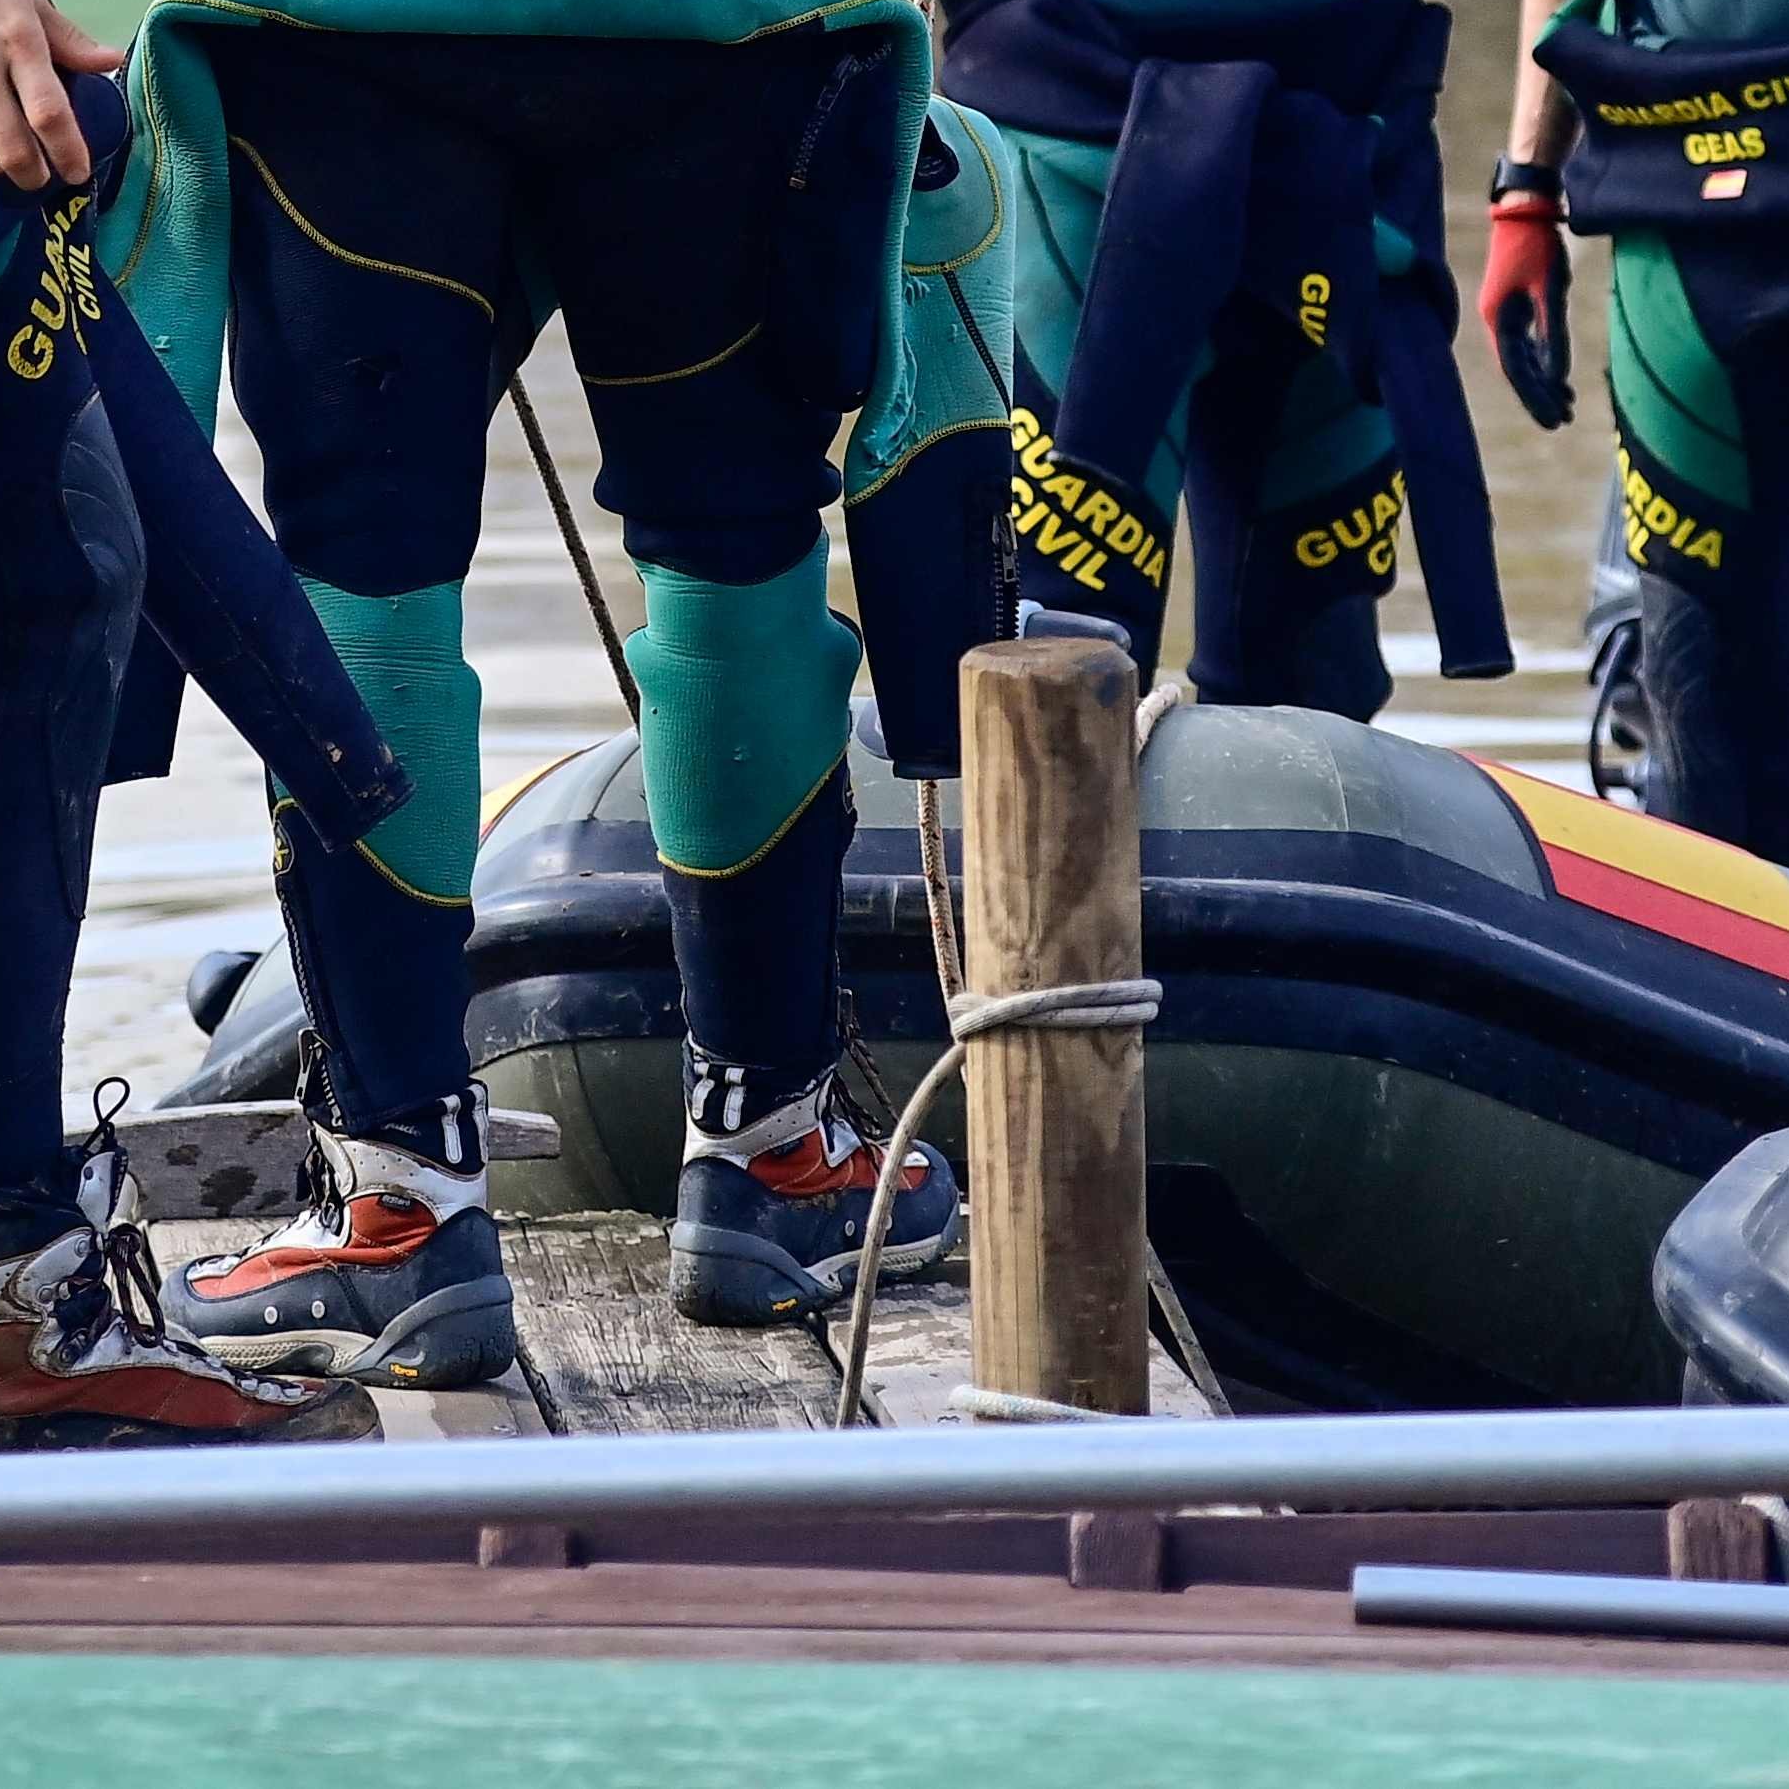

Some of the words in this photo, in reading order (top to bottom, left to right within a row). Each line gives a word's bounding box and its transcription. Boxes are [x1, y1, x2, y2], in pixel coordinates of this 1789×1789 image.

[1598, 90, 1738, 128] GUARDIA
[1683, 127, 1766, 165] GEAS
[68, 243, 101, 320] CIVIL
[1010, 406, 1166, 588] GUARDIA
[1011, 476, 1109, 592] CIVIL
